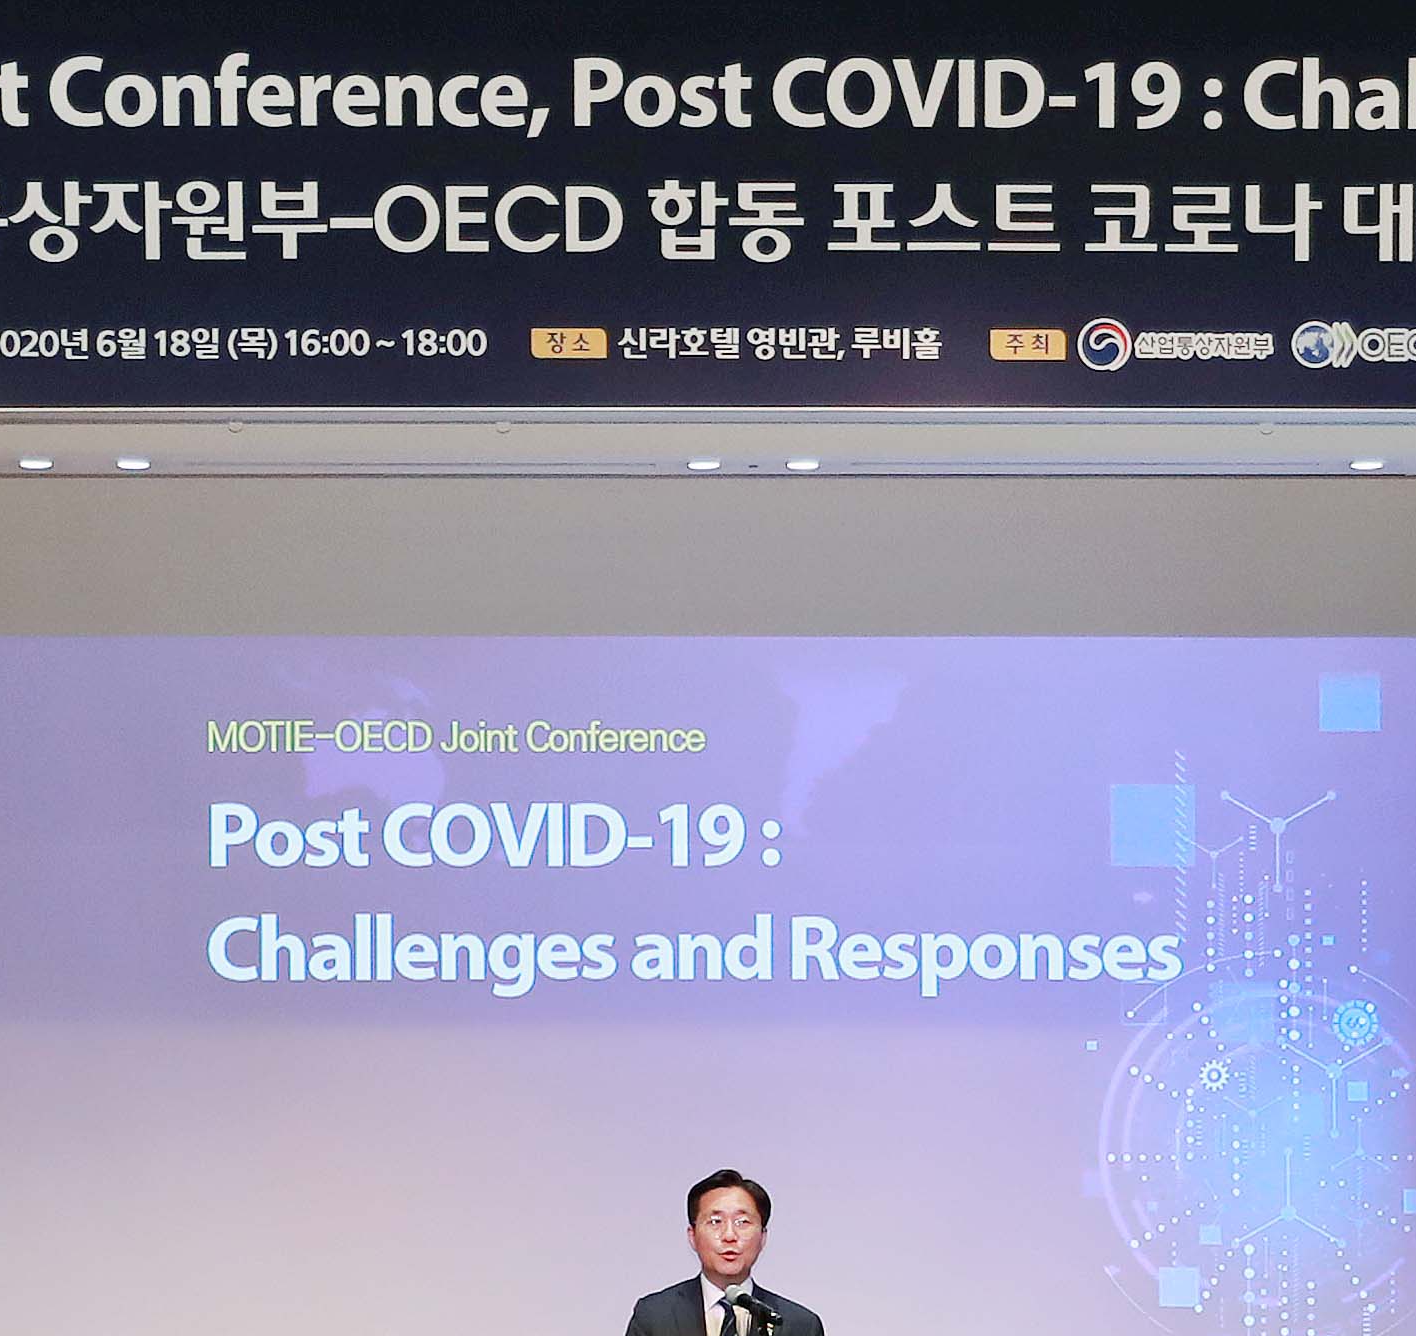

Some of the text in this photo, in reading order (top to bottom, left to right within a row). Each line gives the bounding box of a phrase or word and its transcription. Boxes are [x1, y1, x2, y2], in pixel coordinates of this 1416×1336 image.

[49, 52, 550, 139] Conference,
[573, 57, 753, 128] Post
[647, 179, 805, 263] 합동
[827, 183, 1061, 252] 포스트
[1084, 182, 1323, 262] 코로나
[96, 327, 146, 360] 6월
[153, 327, 220, 360] 18일
[227, 327, 278, 361] (목)
[284, 328, 371, 357] 16:00
[401, 328, 488, 357] 18:00
[617, 327, 943, 361] 신라호텔 영빈관, 루비홀
[1137, 333, 1274, 359] 산업통상자원부
[207, 720, 707, 753] MOTIE-OECD Joint Conference
[210, 802, 370, 868] Post
[207, 913, 1183, 998] Challenges and Responses
